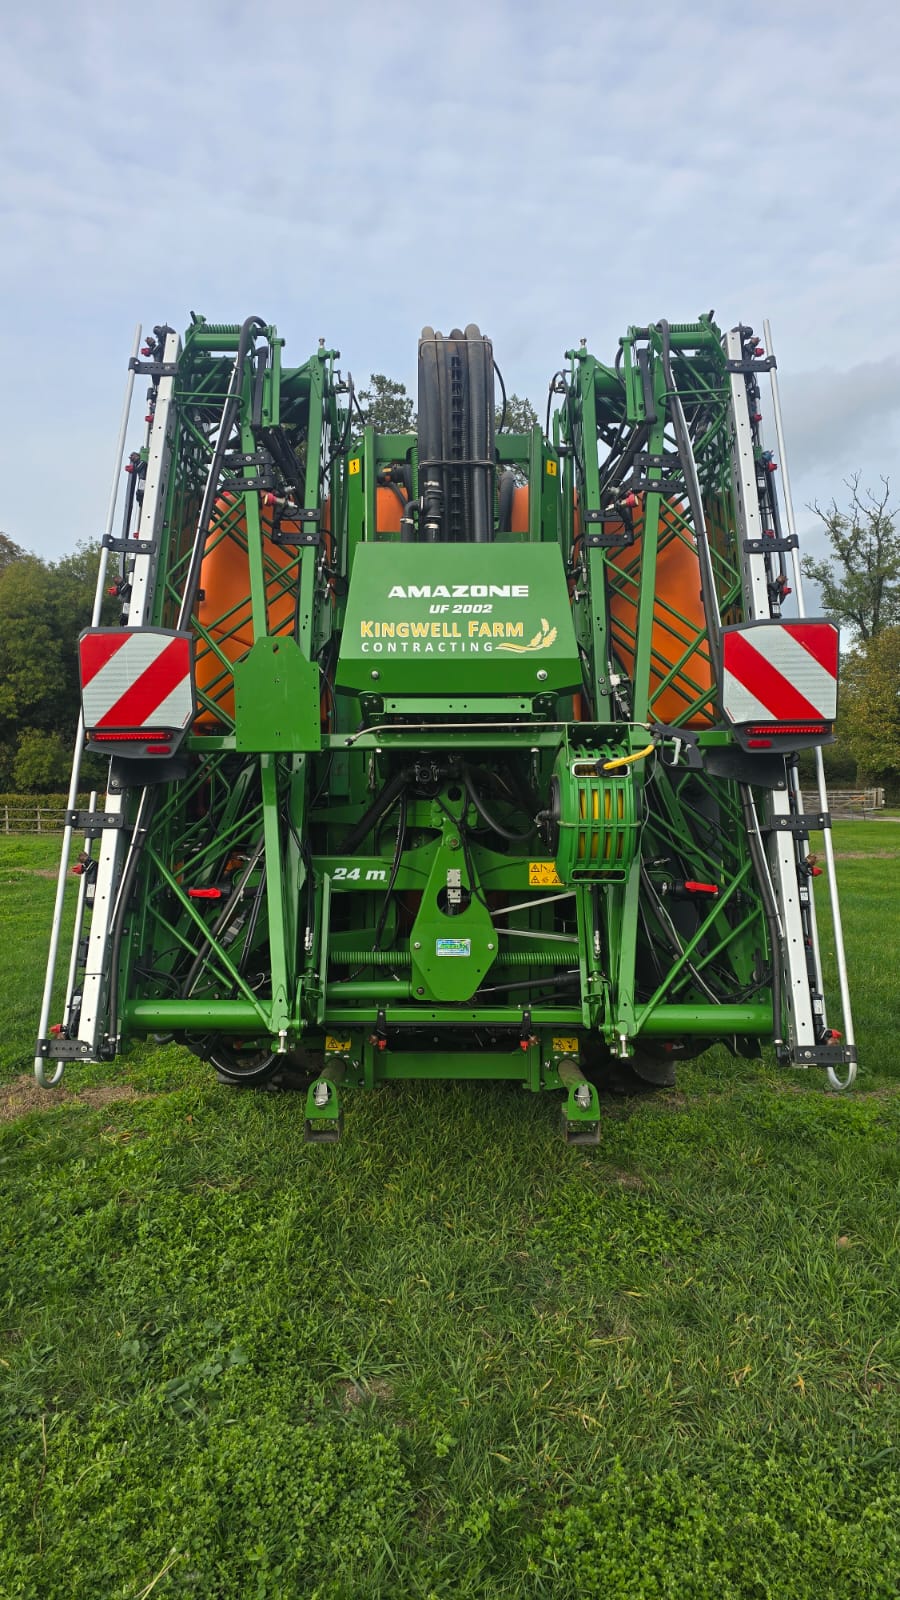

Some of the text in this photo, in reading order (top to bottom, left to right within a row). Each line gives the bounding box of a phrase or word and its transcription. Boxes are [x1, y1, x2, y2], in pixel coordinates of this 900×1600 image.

[388, 585, 529, 598] AMAZONE
[429, 604, 493, 614] UF 2002
[360, 620, 524, 638] KINGWELL FARM
[361, 642, 493, 653] CONTRACTING
[332, 867, 386, 880] 24 m
